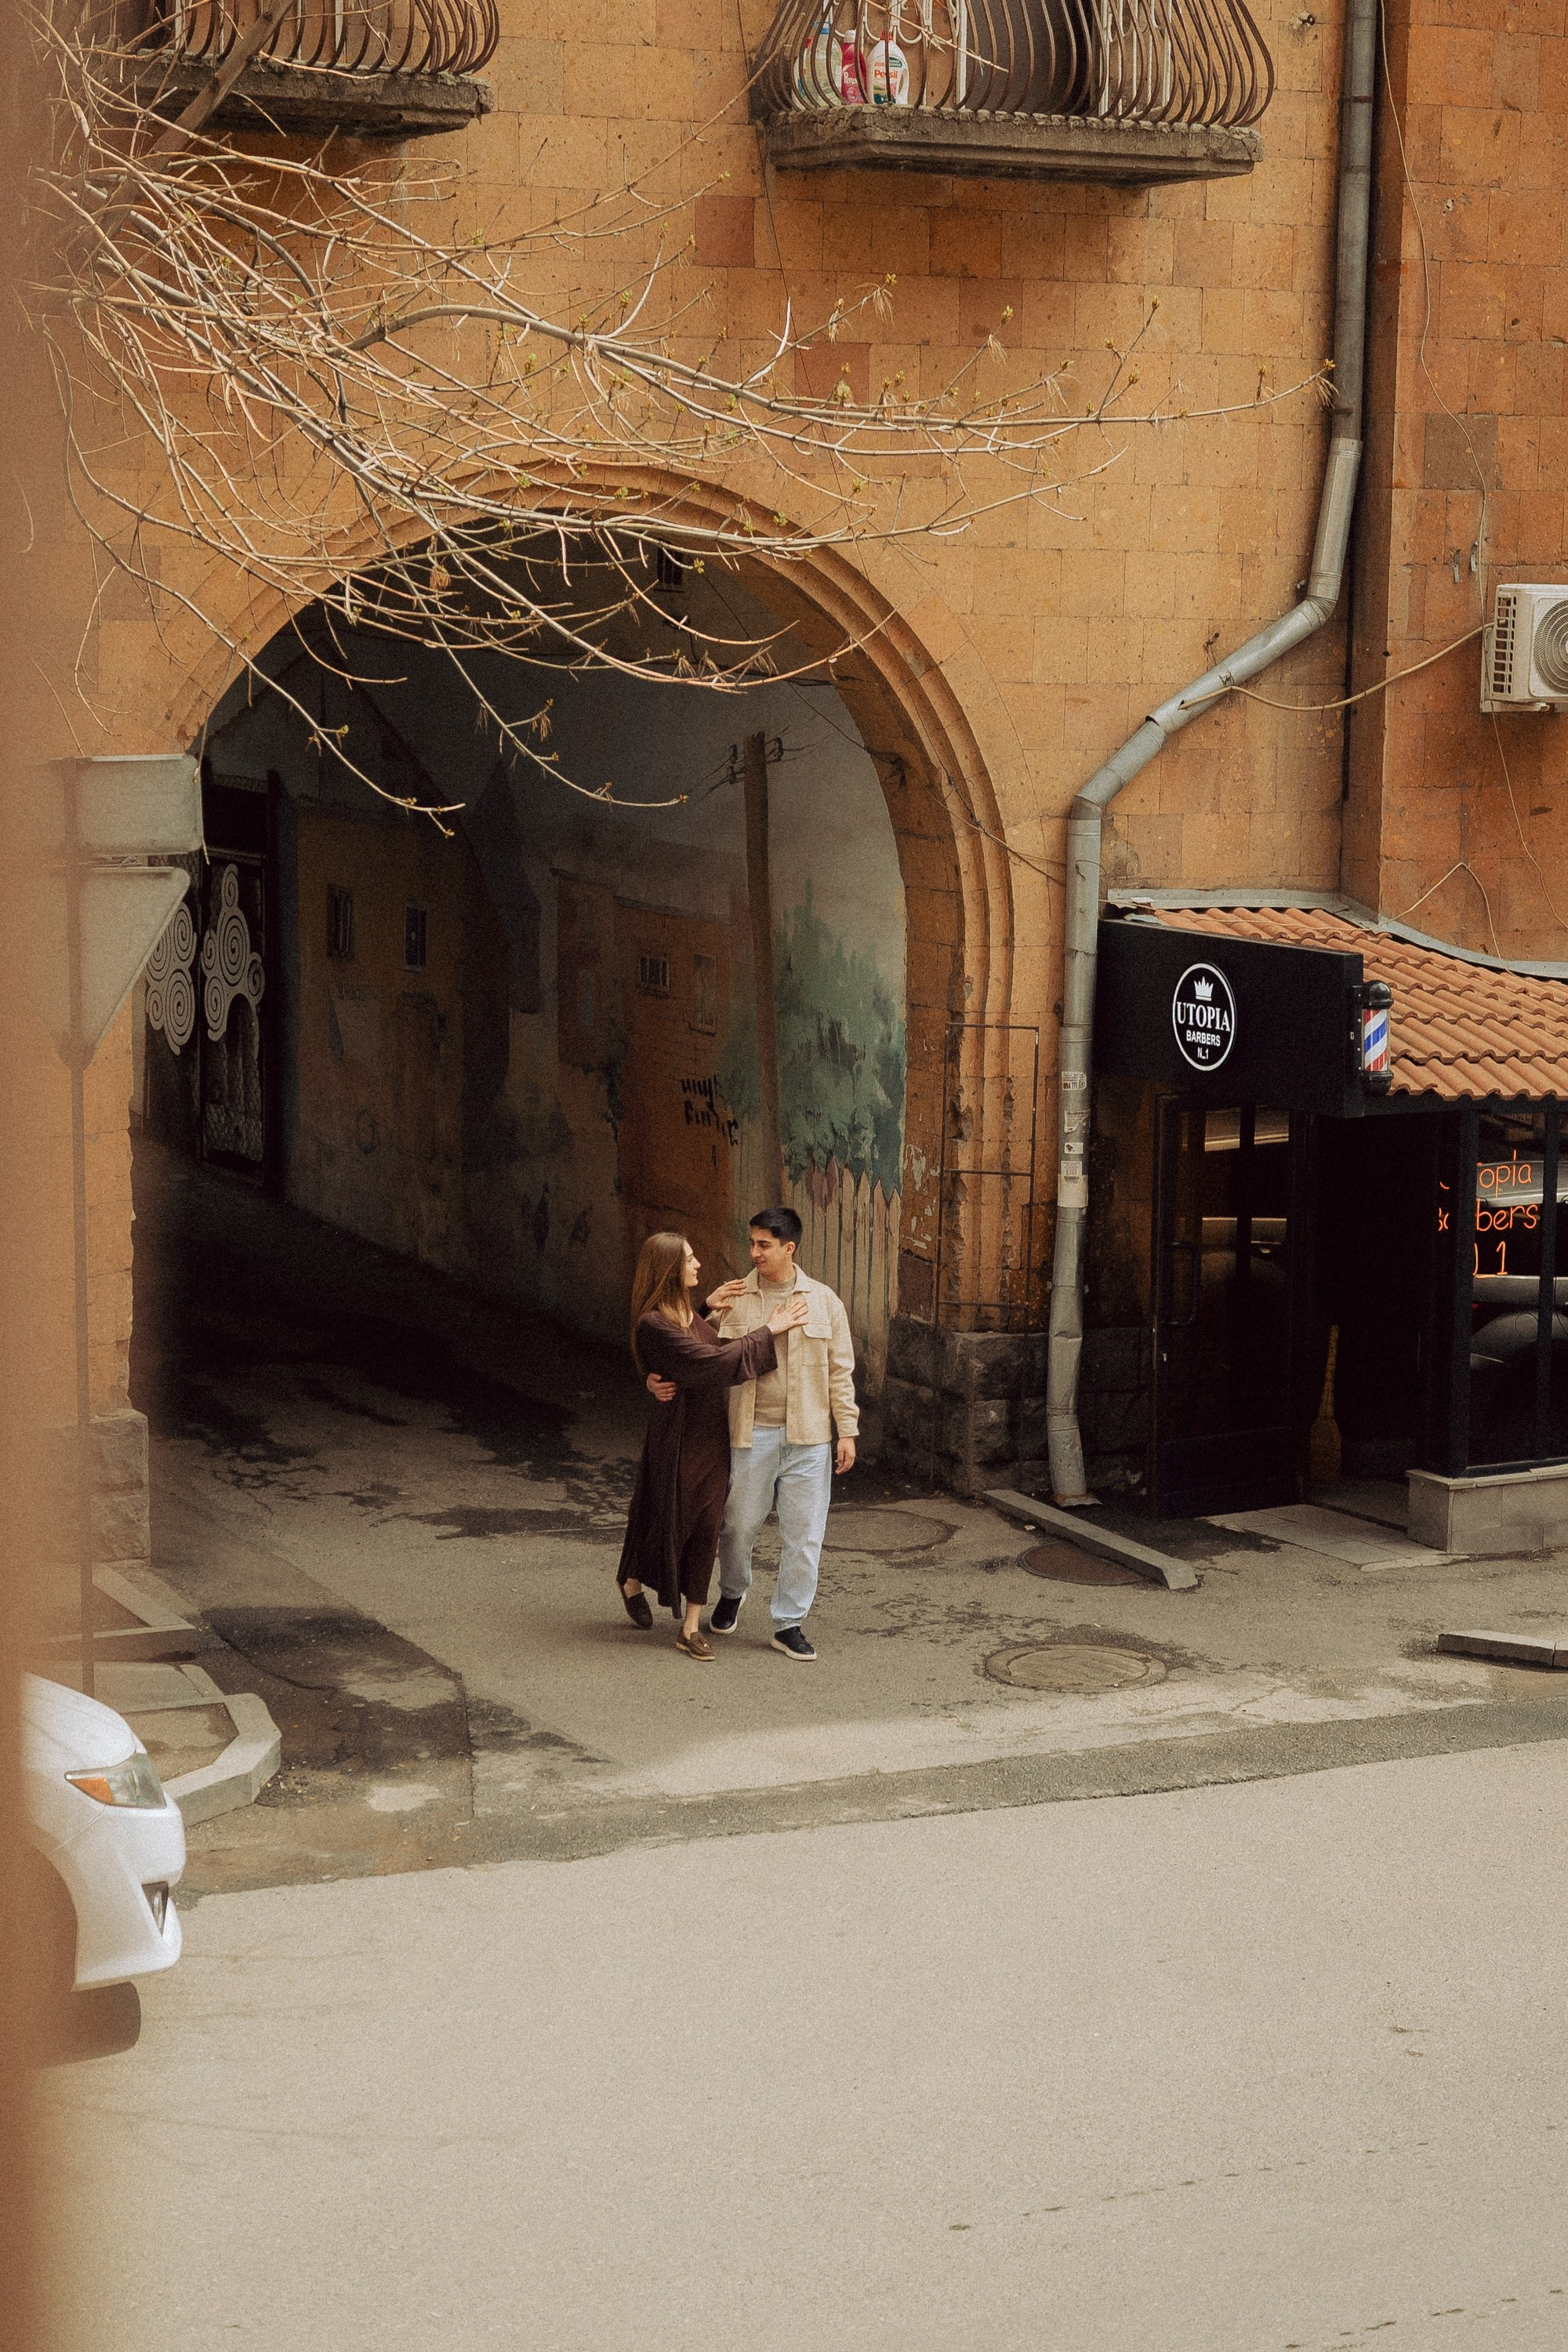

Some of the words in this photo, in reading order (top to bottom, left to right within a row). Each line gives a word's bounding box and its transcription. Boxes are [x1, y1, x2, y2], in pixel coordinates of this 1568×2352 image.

[874, 70, 898, 78] Pesil
[1177, 1001, 1230, 1032] UTOPIA
[1186, 1029, 1221, 1047] BARBERS
